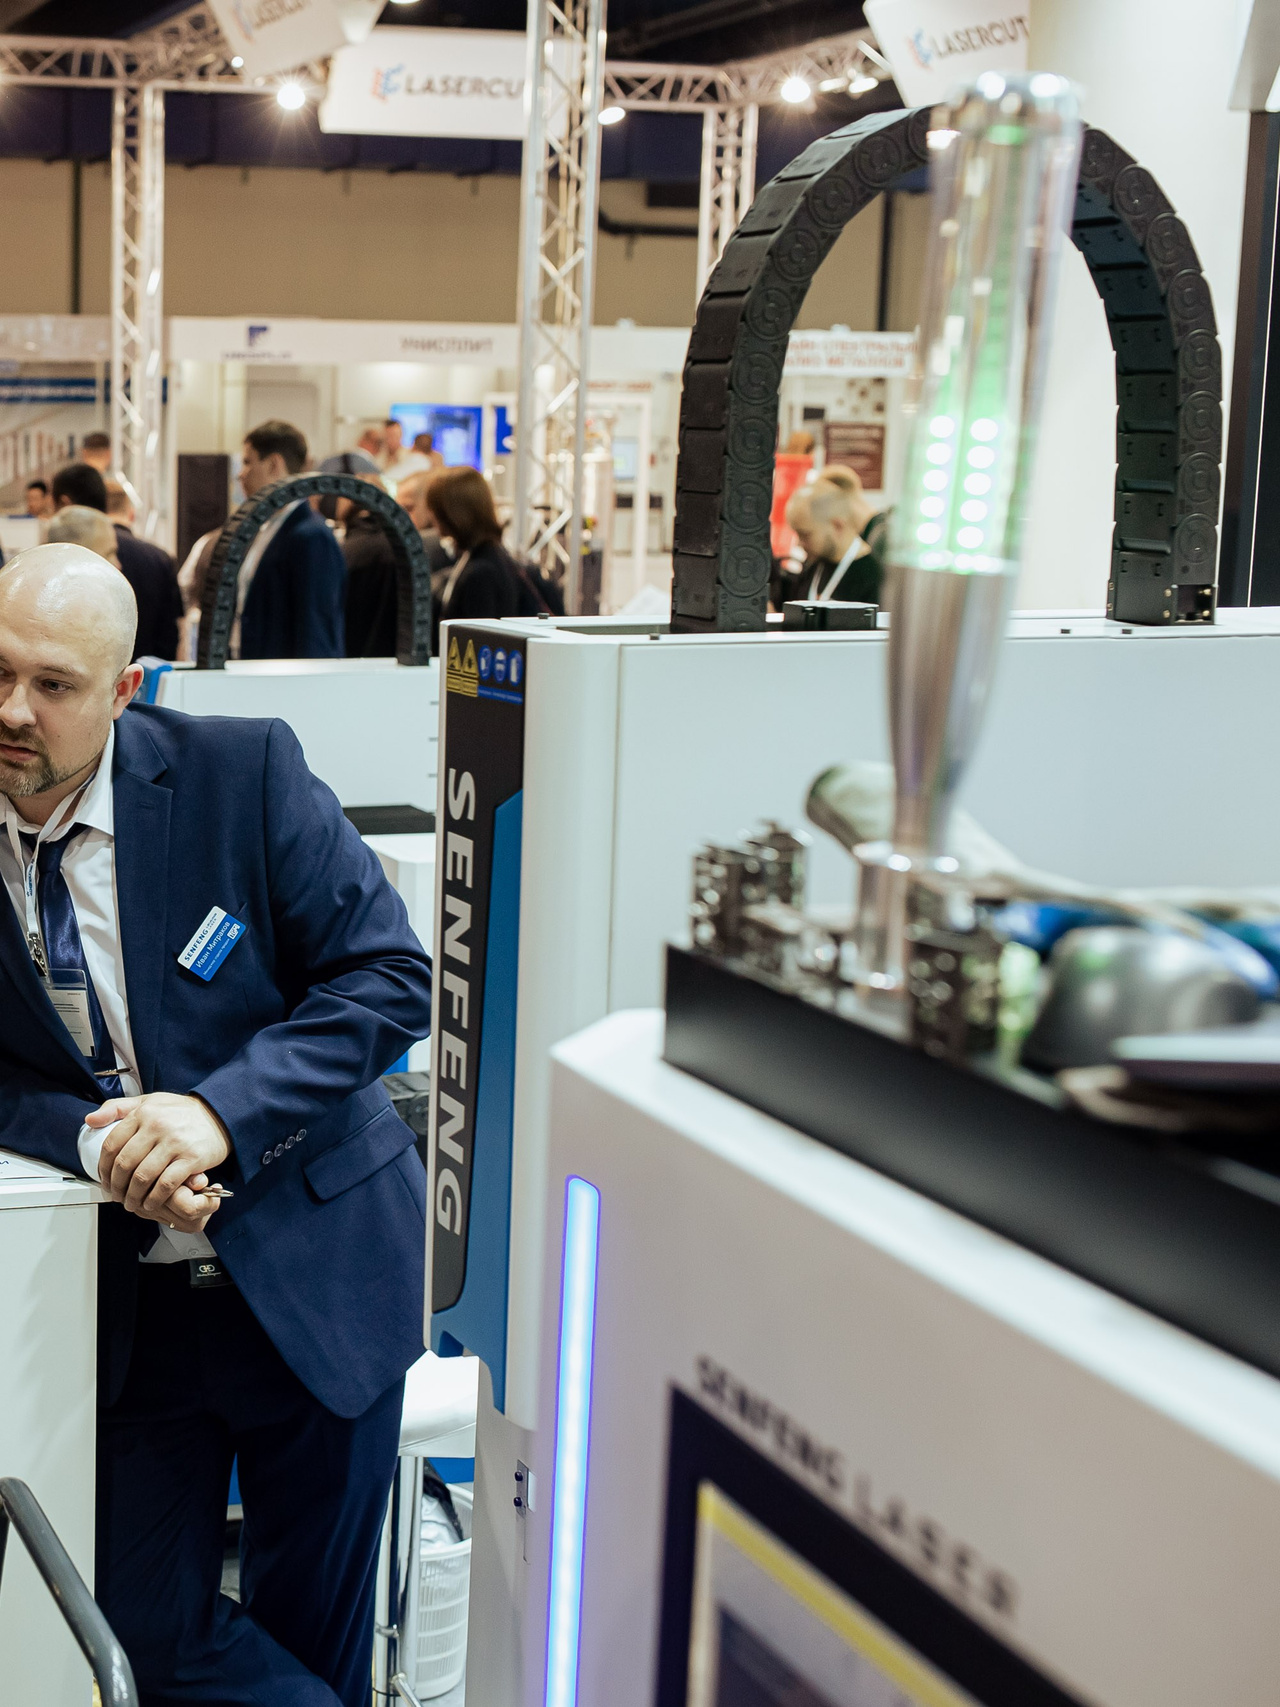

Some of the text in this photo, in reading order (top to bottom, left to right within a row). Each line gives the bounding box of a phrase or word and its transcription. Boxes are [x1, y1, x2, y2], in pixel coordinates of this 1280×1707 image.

[932, 15, 1030, 59] LASERCUT
[405, 73, 527, 99] LASERCU
[184, 928, 209, 962] SENFENG
[195, 951, 211, 968] Иван
[207, 921, 231, 952] Митраков
[435, 766, 477, 1236] SENFENG
[694, 1354, 1020, 1617] SENFENG LASER
